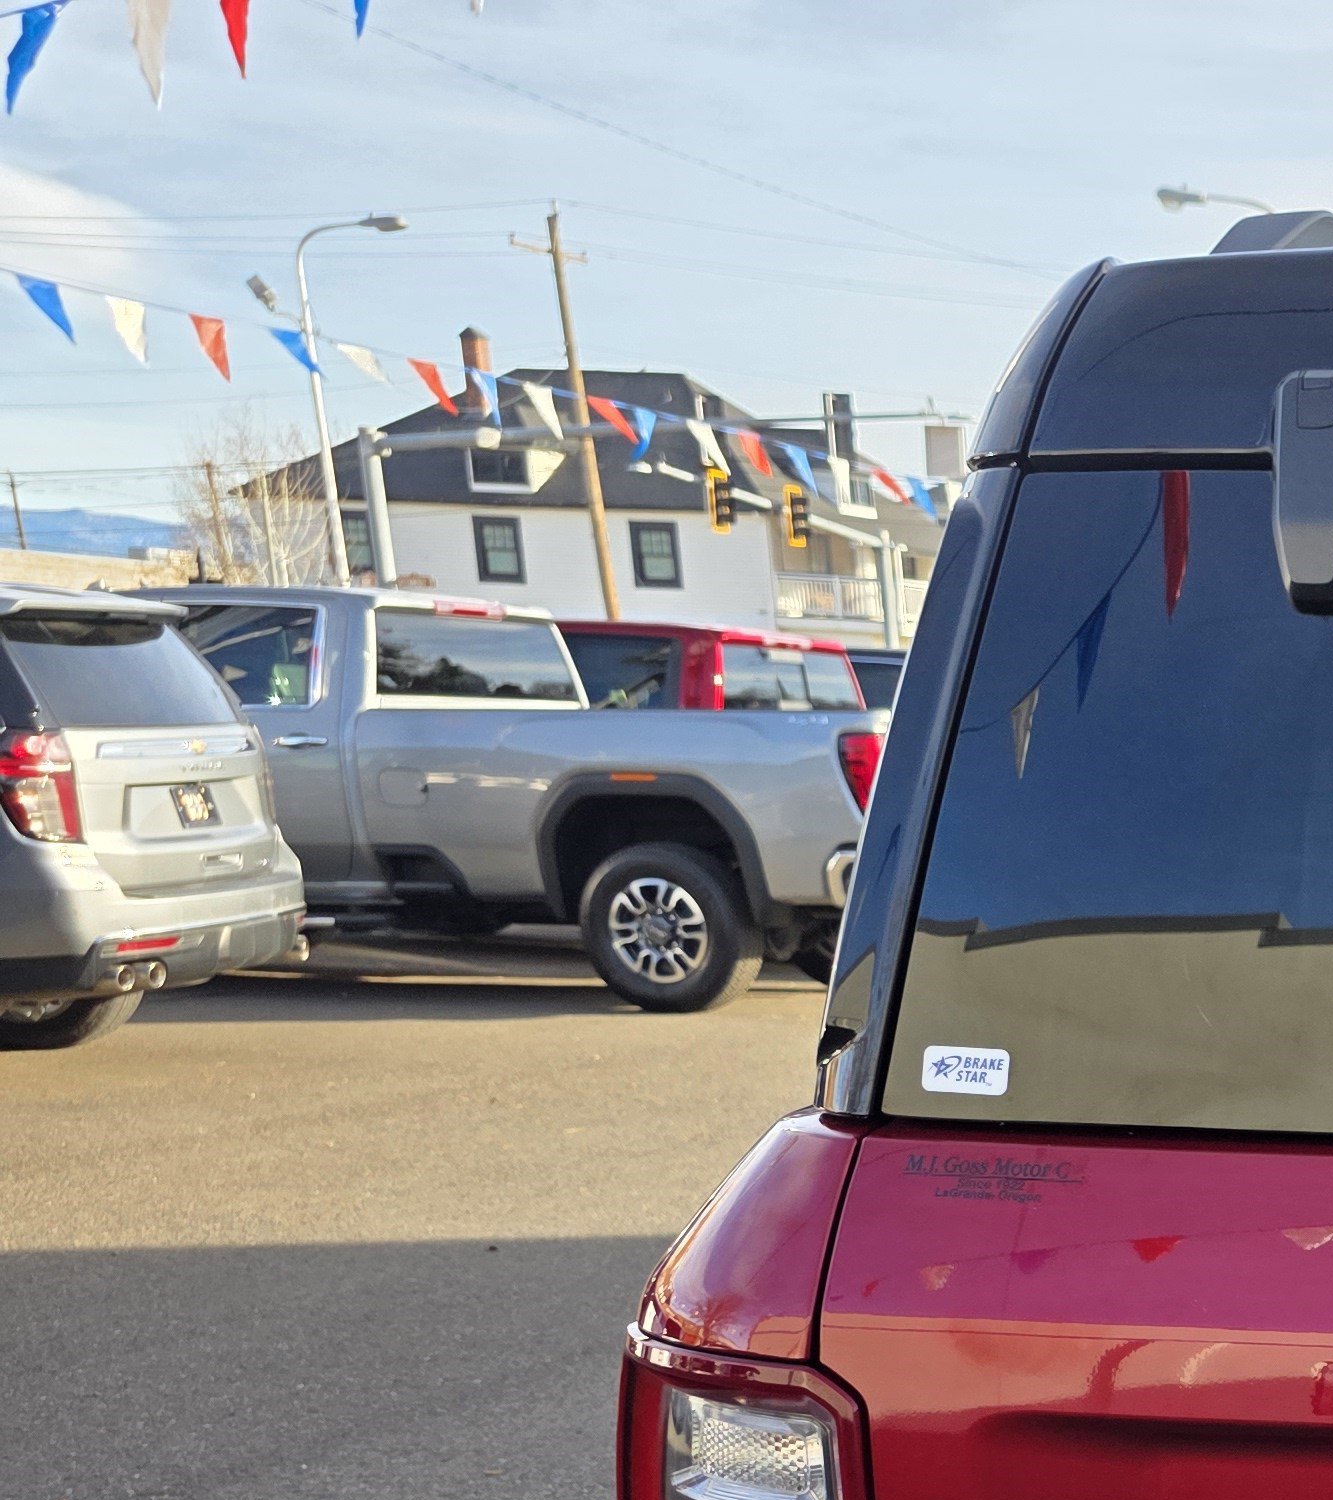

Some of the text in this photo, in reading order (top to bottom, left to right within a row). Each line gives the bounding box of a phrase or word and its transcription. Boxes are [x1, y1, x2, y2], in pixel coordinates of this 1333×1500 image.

[963, 1056, 1005, 1071] BRAKE
[955, 1070, 988, 1084] STAR
[903, 1154, 938, 1176] M.J.
[944, 1156, 987, 1175] Goss
[992, 1157, 1052, 1178] Motor
